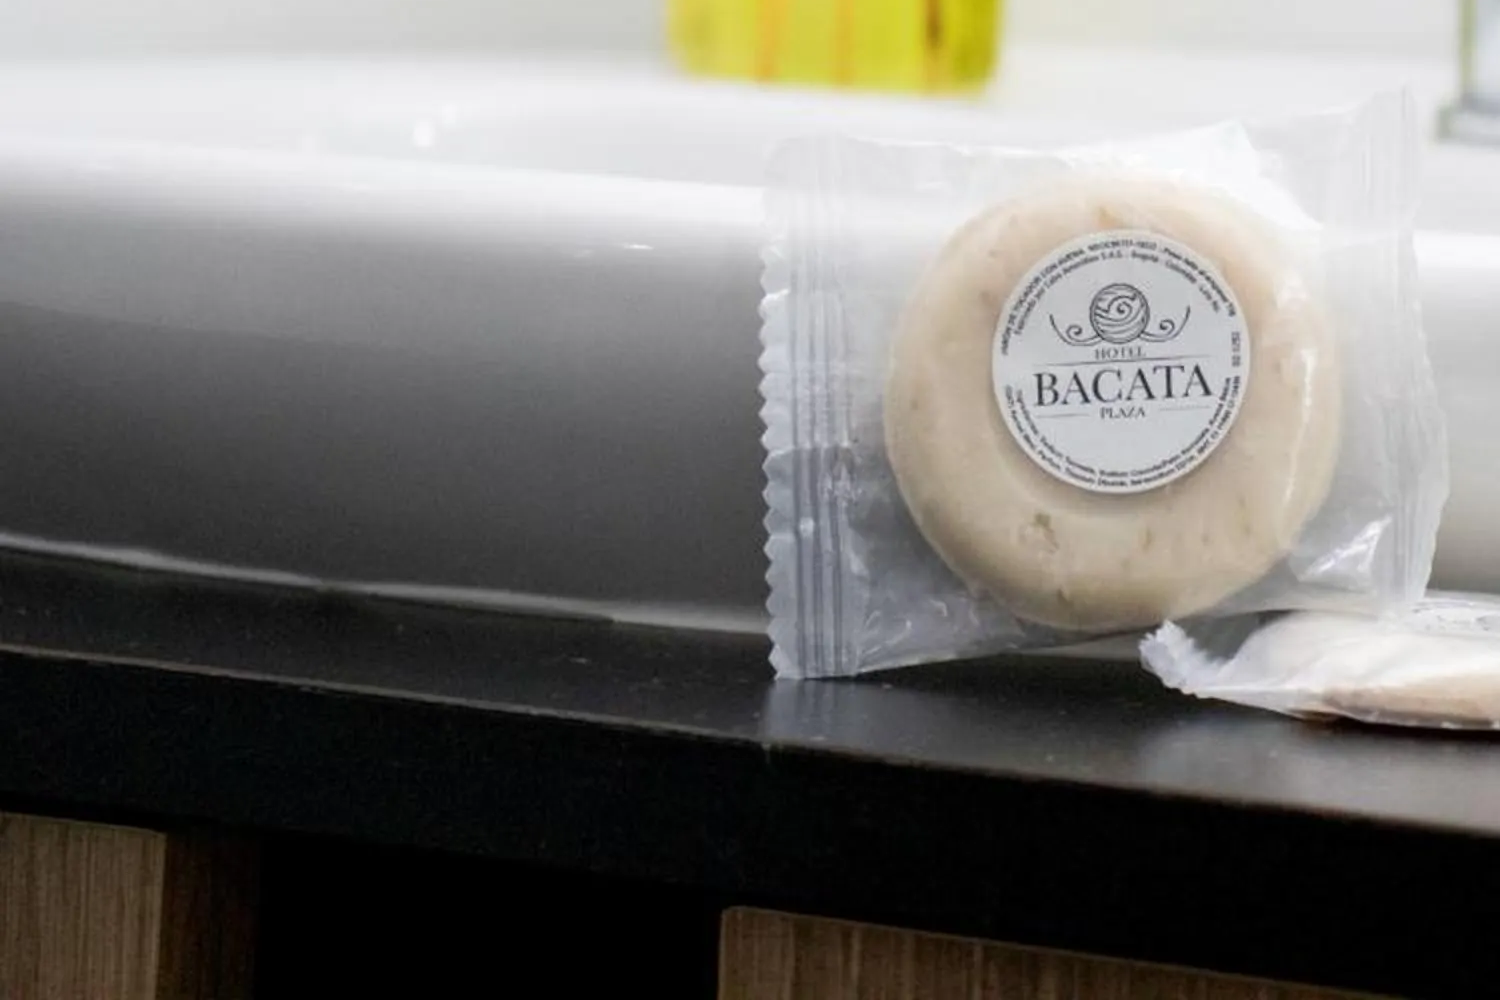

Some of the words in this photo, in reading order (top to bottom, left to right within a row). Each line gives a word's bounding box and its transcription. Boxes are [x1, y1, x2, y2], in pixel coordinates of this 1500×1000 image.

[1095, 346, 1147, 361] HOTEL
[1033, 363, 1212, 407] BACATA
[1100, 406, 1146, 420] PLAZA
